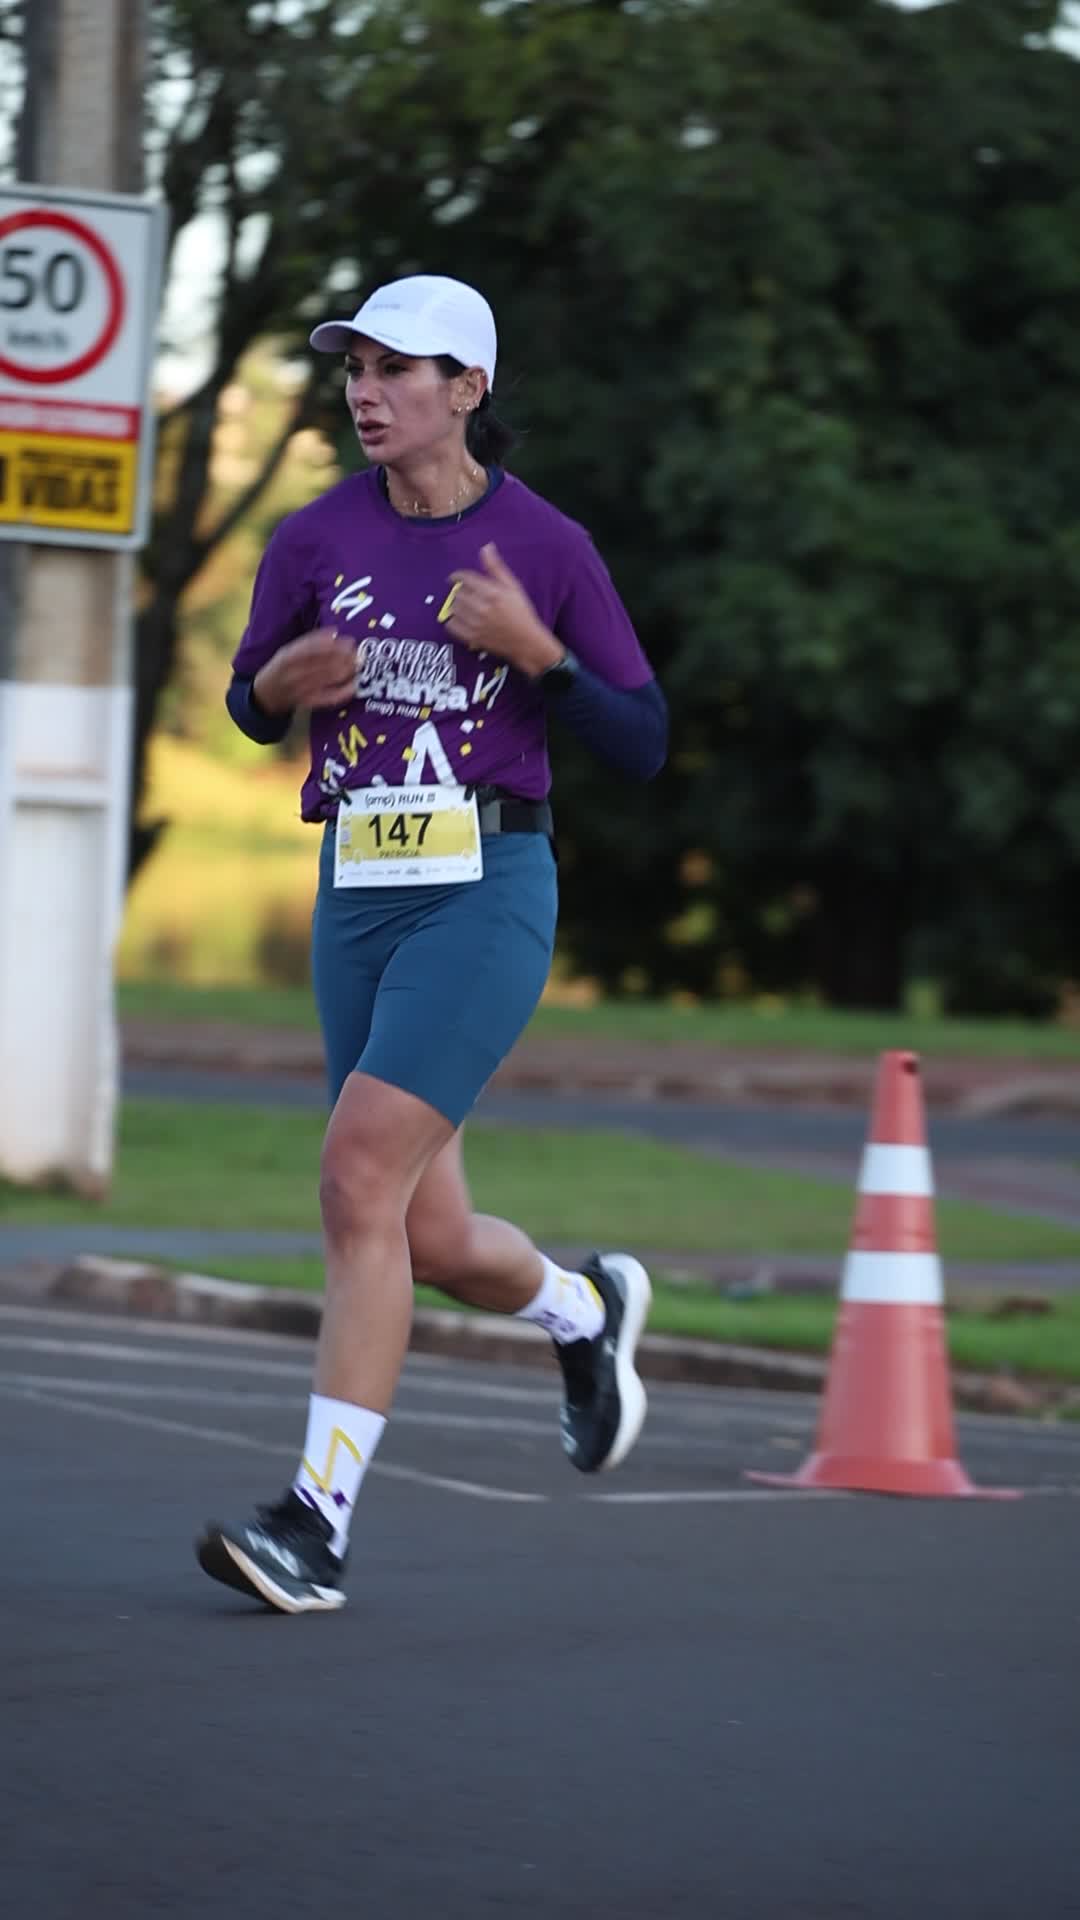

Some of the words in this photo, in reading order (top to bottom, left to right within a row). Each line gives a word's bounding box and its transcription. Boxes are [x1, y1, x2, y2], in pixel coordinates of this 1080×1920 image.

[0, 247, 86, 315] 50
[398, 794, 424, 804] RUN
[368, 813, 433, 848] 147
